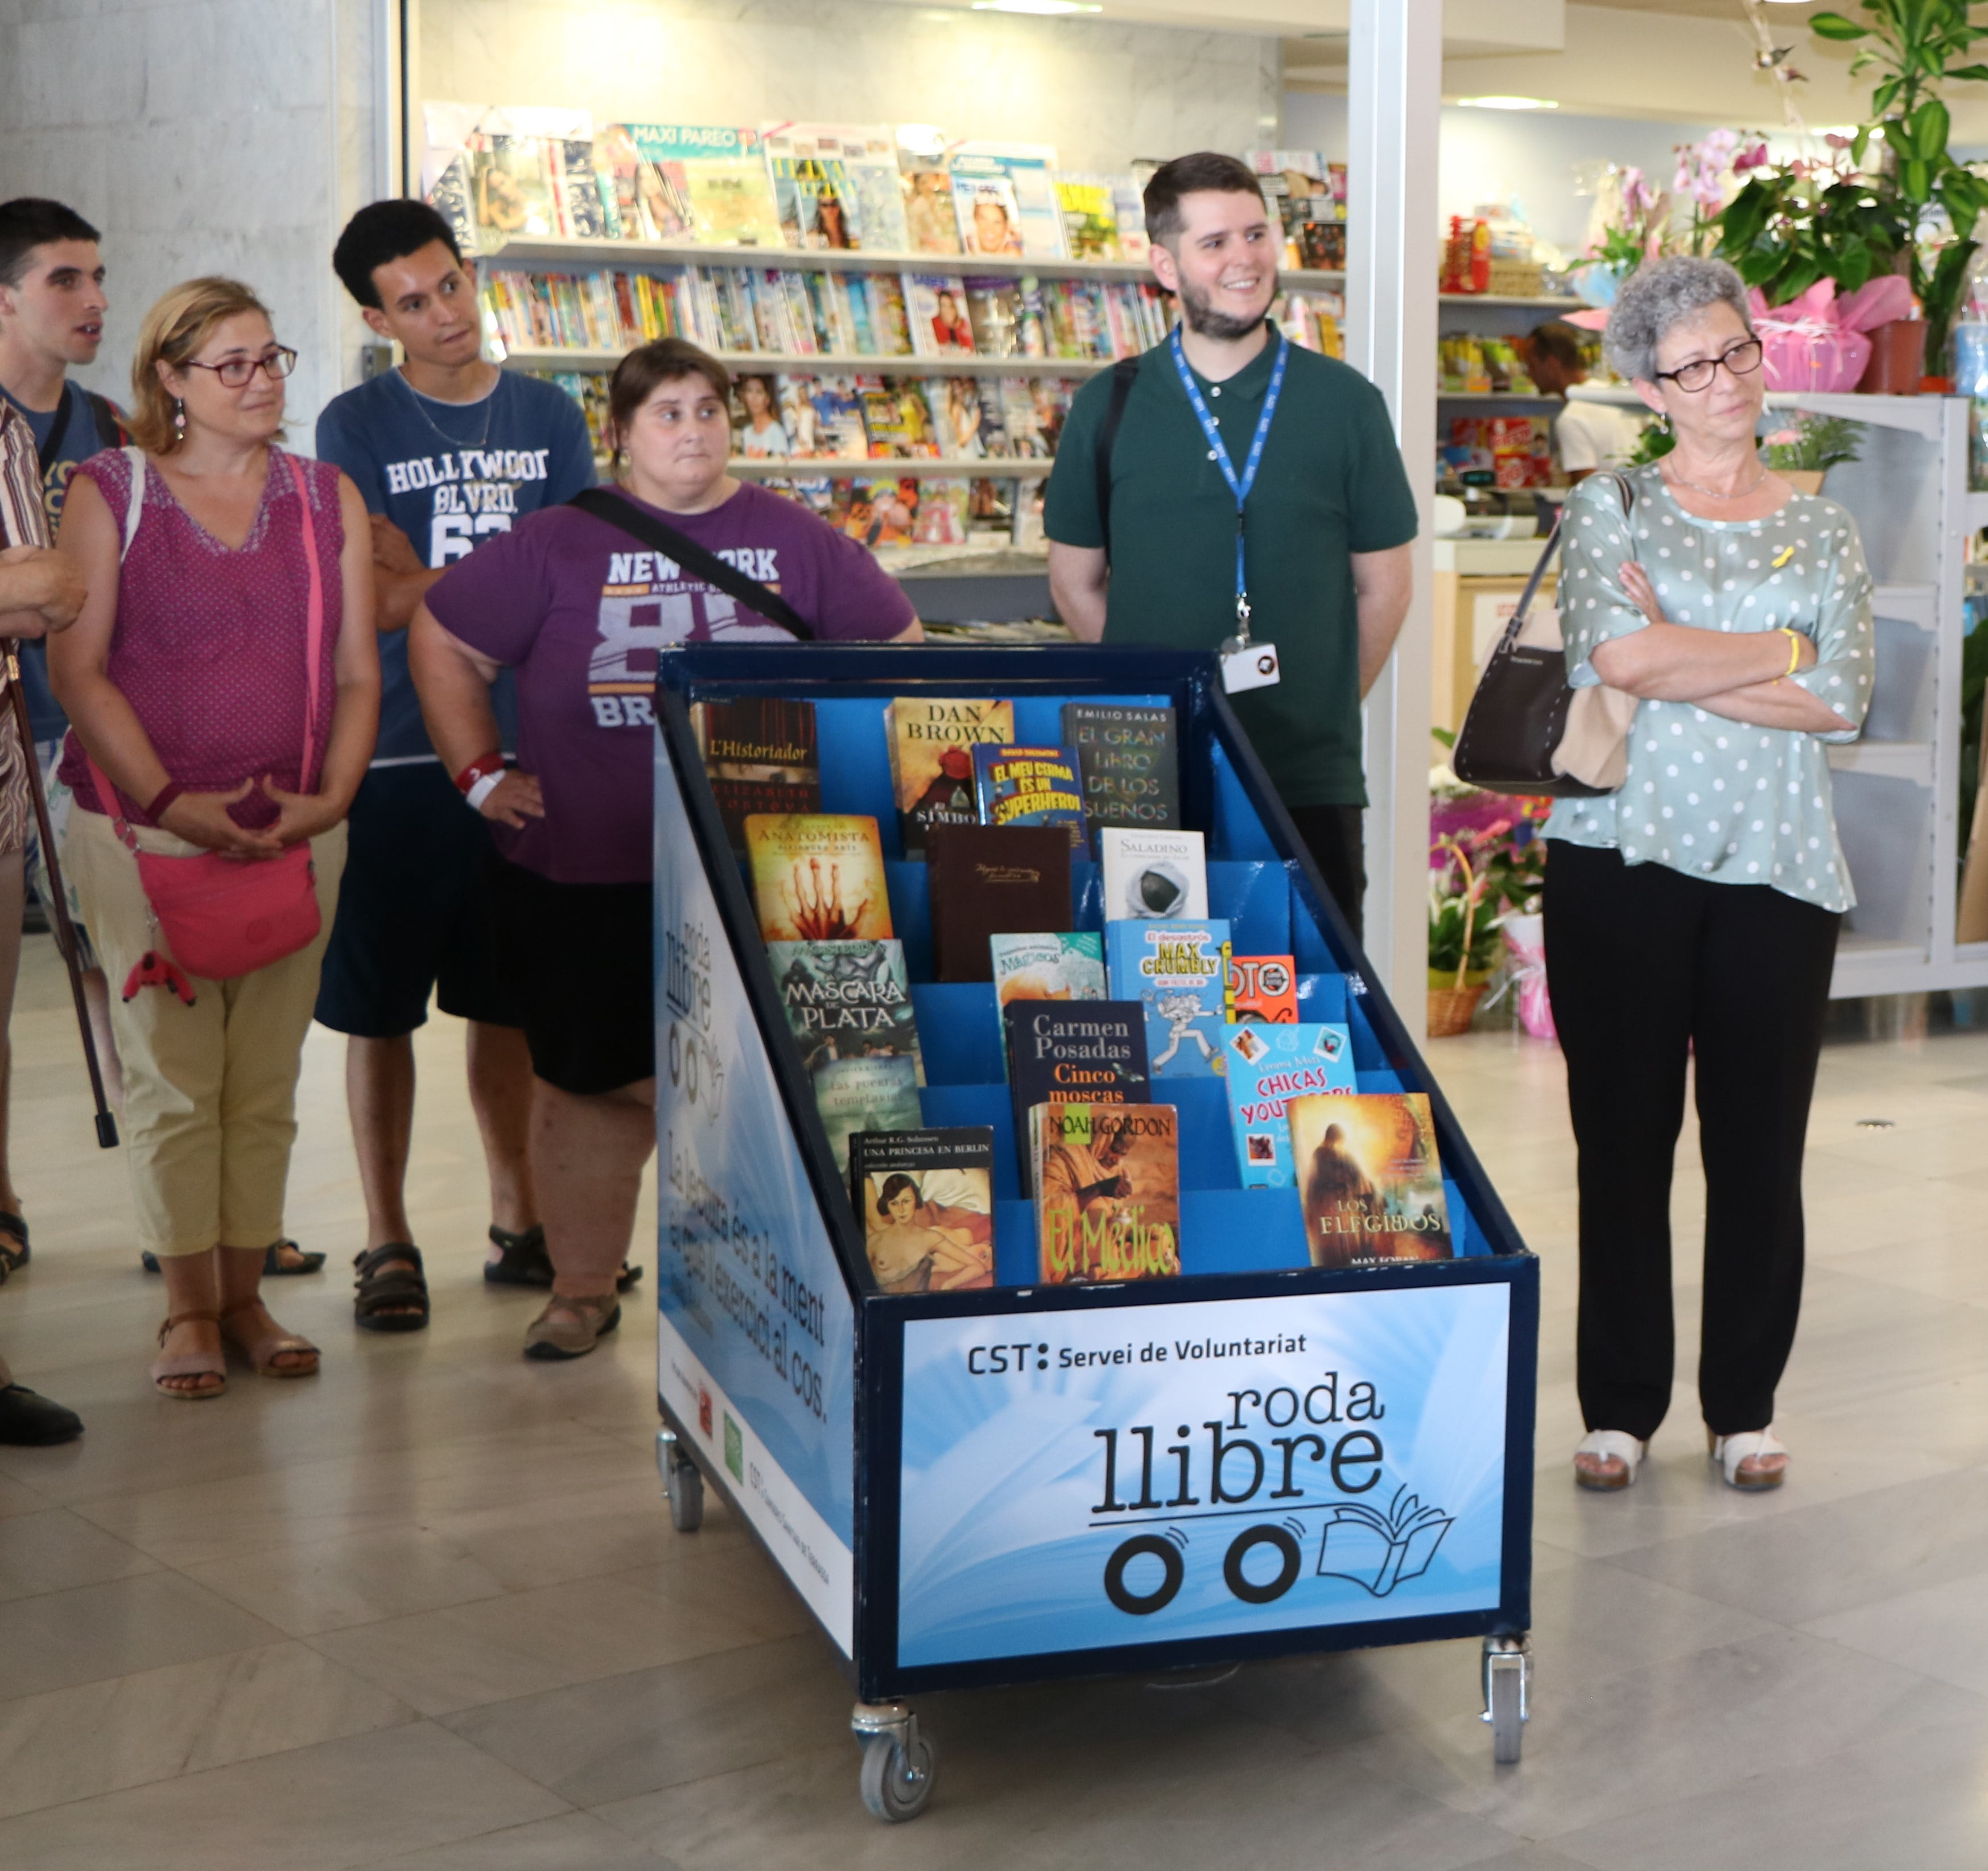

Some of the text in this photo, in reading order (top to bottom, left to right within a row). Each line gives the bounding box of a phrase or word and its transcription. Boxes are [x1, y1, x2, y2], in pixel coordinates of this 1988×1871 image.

[633, 126, 736, 147] MAXI PAREO
[430, 514, 512, 569] 6
[607, 547, 780, 584] NEW RK
[651, 583, 706, 593] ATHLETIC
[591, 695, 656, 727] BR
[928, 705, 980, 722] DAN
[1077, 709, 1166, 722] EMILIO SALAS
[907, 723, 1005, 743] BROWN
[1079, 726, 1166, 745] EL GRAN
[710, 740, 807, 760] L'Historiador
[995, 764, 1008, 782] EL
[1009, 761, 1033, 777] MEU
[1037, 777, 1051, 791] UN
[1088, 776, 1159, 796] DE LOS
[995, 792, 1081, 825] SUPERHEROI
[758, 829, 869, 842] ANATOMISTA
[1121, 838, 1188, 853] SALADINO
[1159, 942, 1199, 960] MAX
[1143, 959, 1216, 975] CRUMBLY
[666, 931, 711, 1032] llibre
[801, 1007, 896, 1029] PLATA
[1033, 1014, 1129, 1037] Carmen
[1034, 1037, 1131, 1058] Posadas
[1054, 1062, 1116, 1083] Cinco
[1257, 1066, 1327, 1097] CHICAS
[1049, 1090, 1124, 1102] moscas
[1050, 1116, 1170, 1136] NOAH GORDON
[864, 1144, 990, 1157] UNA PRINCESA EN BERLIN
[1338, 1200, 1368, 1212] LOS
[1320, 1213, 1441, 1235] ELEGIDOS
[1049, 1206, 1075, 1274] El
[733, 1199, 748, 1264] és
[765, 1230, 778, 1298] la
[782, 1264, 824, 1347] ment
[1059, 1343, 1132, 1367] Servei
[1140, 1341, 1167, 1363] de
[1175, 1333, 1306, 1361] Voluntariat
[774, 1320, 787, 1382] al
[792, 1350, 827, 1425] cos.
[1226, 1371, 1385, 1431] roda
[1091, 1421, 1383, 1513] llibre
